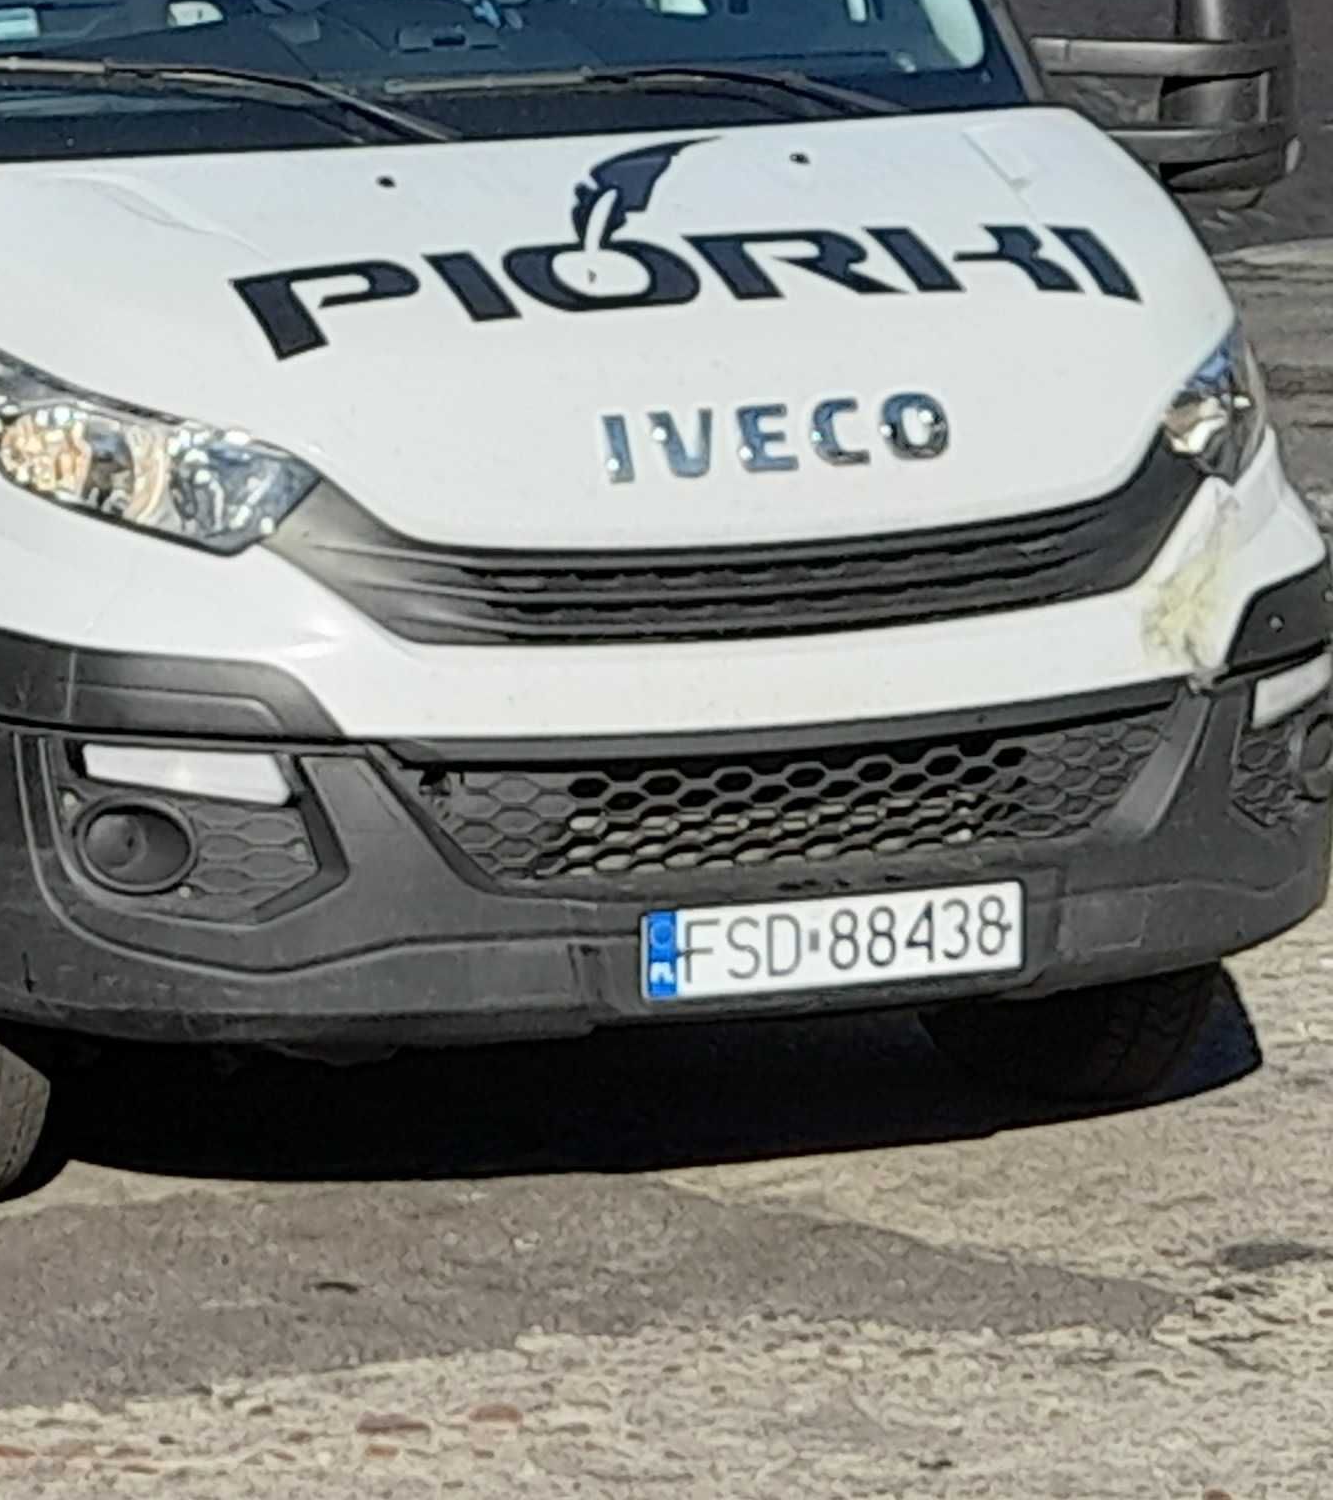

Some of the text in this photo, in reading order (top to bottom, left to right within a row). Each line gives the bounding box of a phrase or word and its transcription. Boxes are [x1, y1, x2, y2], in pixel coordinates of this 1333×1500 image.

[600, 391, 950, 483] IVECO
[681, 894, 1009, 984] FSD 88438
